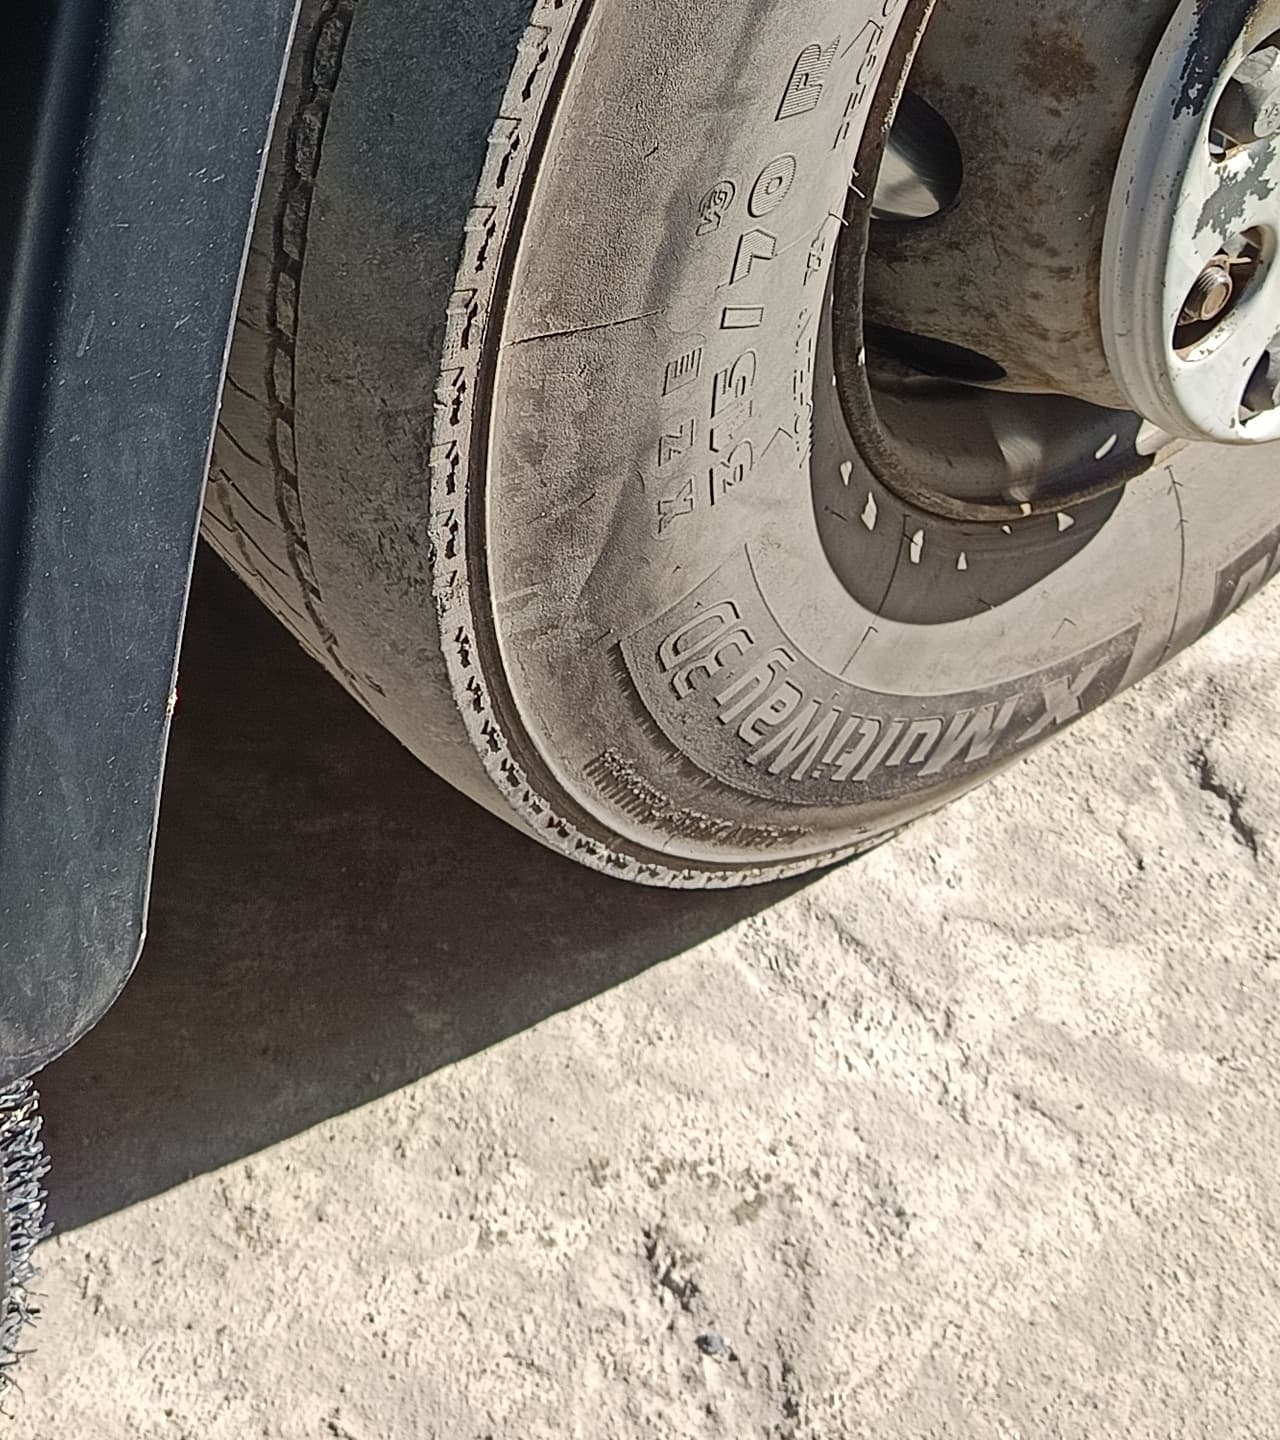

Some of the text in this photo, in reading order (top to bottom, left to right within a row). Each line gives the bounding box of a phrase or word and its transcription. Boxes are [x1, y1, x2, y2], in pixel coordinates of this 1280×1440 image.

[775, 37, 842, 122] R
[656, 600, 1110, 783] X MultiWay 3D
